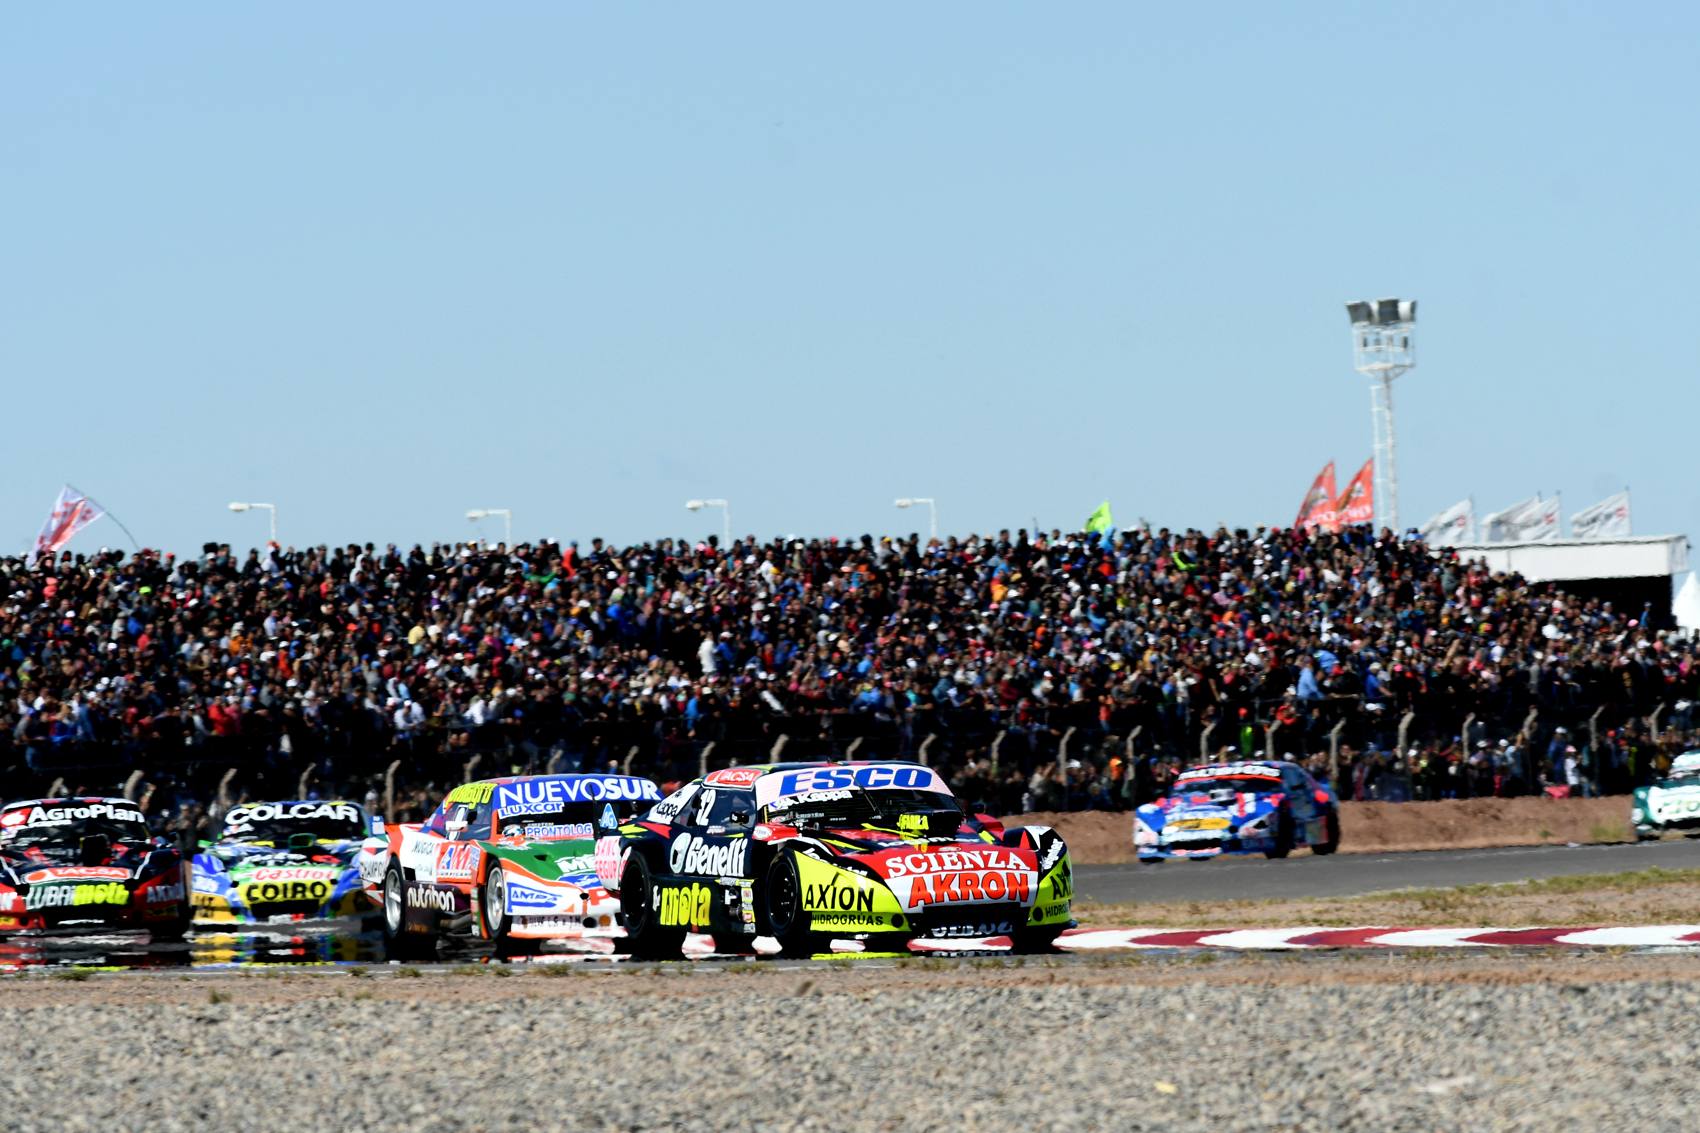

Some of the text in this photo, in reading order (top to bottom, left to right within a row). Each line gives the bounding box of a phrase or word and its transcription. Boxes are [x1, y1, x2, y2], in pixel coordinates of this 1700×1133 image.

[499, 778, 662, 808] NUEVOSUR
[779, 767, 933, 797] ESCO
[27, 804, 145, 823] AgroPlan
[224, 803, 358, 825] COLCAR
[526, 824, 592, 836] PRONTOLOG
[684, 837, 748, 877] Benelli
[885, 850, 1031, 878] SCIENZA
[255, 868, 335, 881] Castrol
[246, 881, 328, 901] COIRO
[804, 874, 874, 912] AXION
[908, 871, 1030, 909] AKRON
[812, 914, 884, 926] HIDROGRUAS
